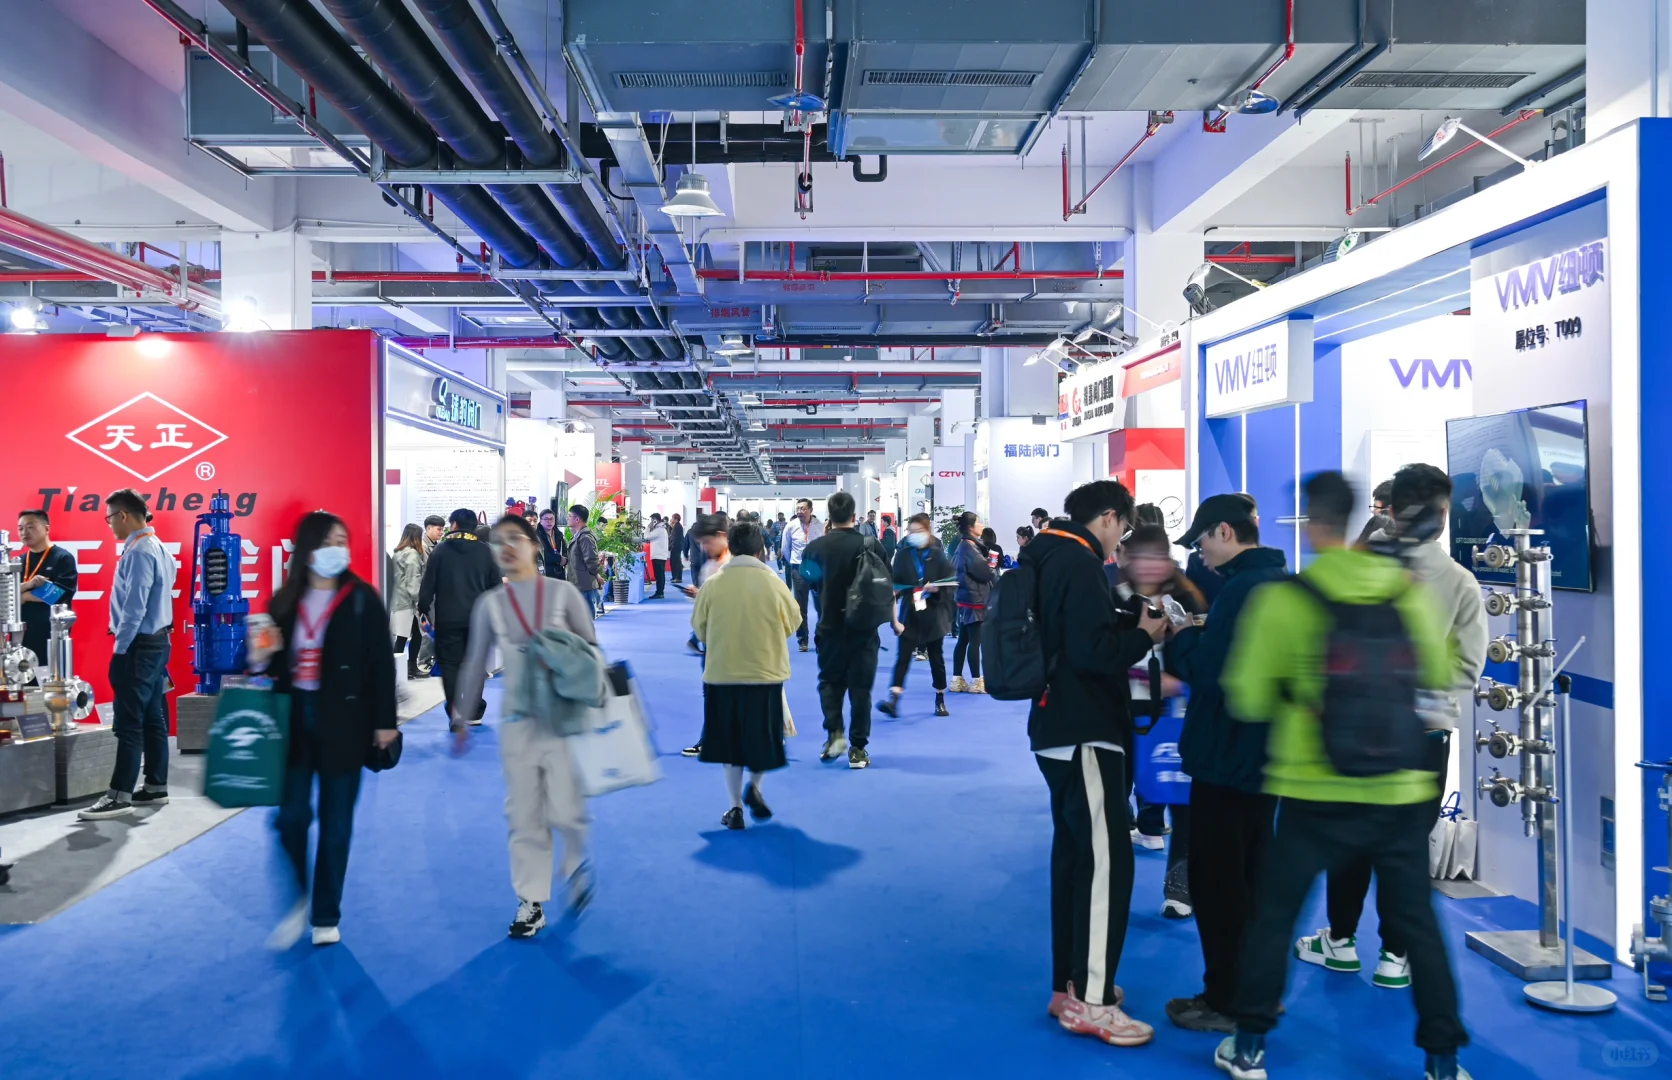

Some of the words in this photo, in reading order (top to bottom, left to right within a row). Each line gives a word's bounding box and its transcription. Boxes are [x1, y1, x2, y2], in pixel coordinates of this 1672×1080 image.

[1554, 316, 1583, 340] T009
[99, 423, 194, 452] 天正
[1004, 444, 1059, 458] 福陆阀门
[38, 486, 258, 517] Tiaheg
